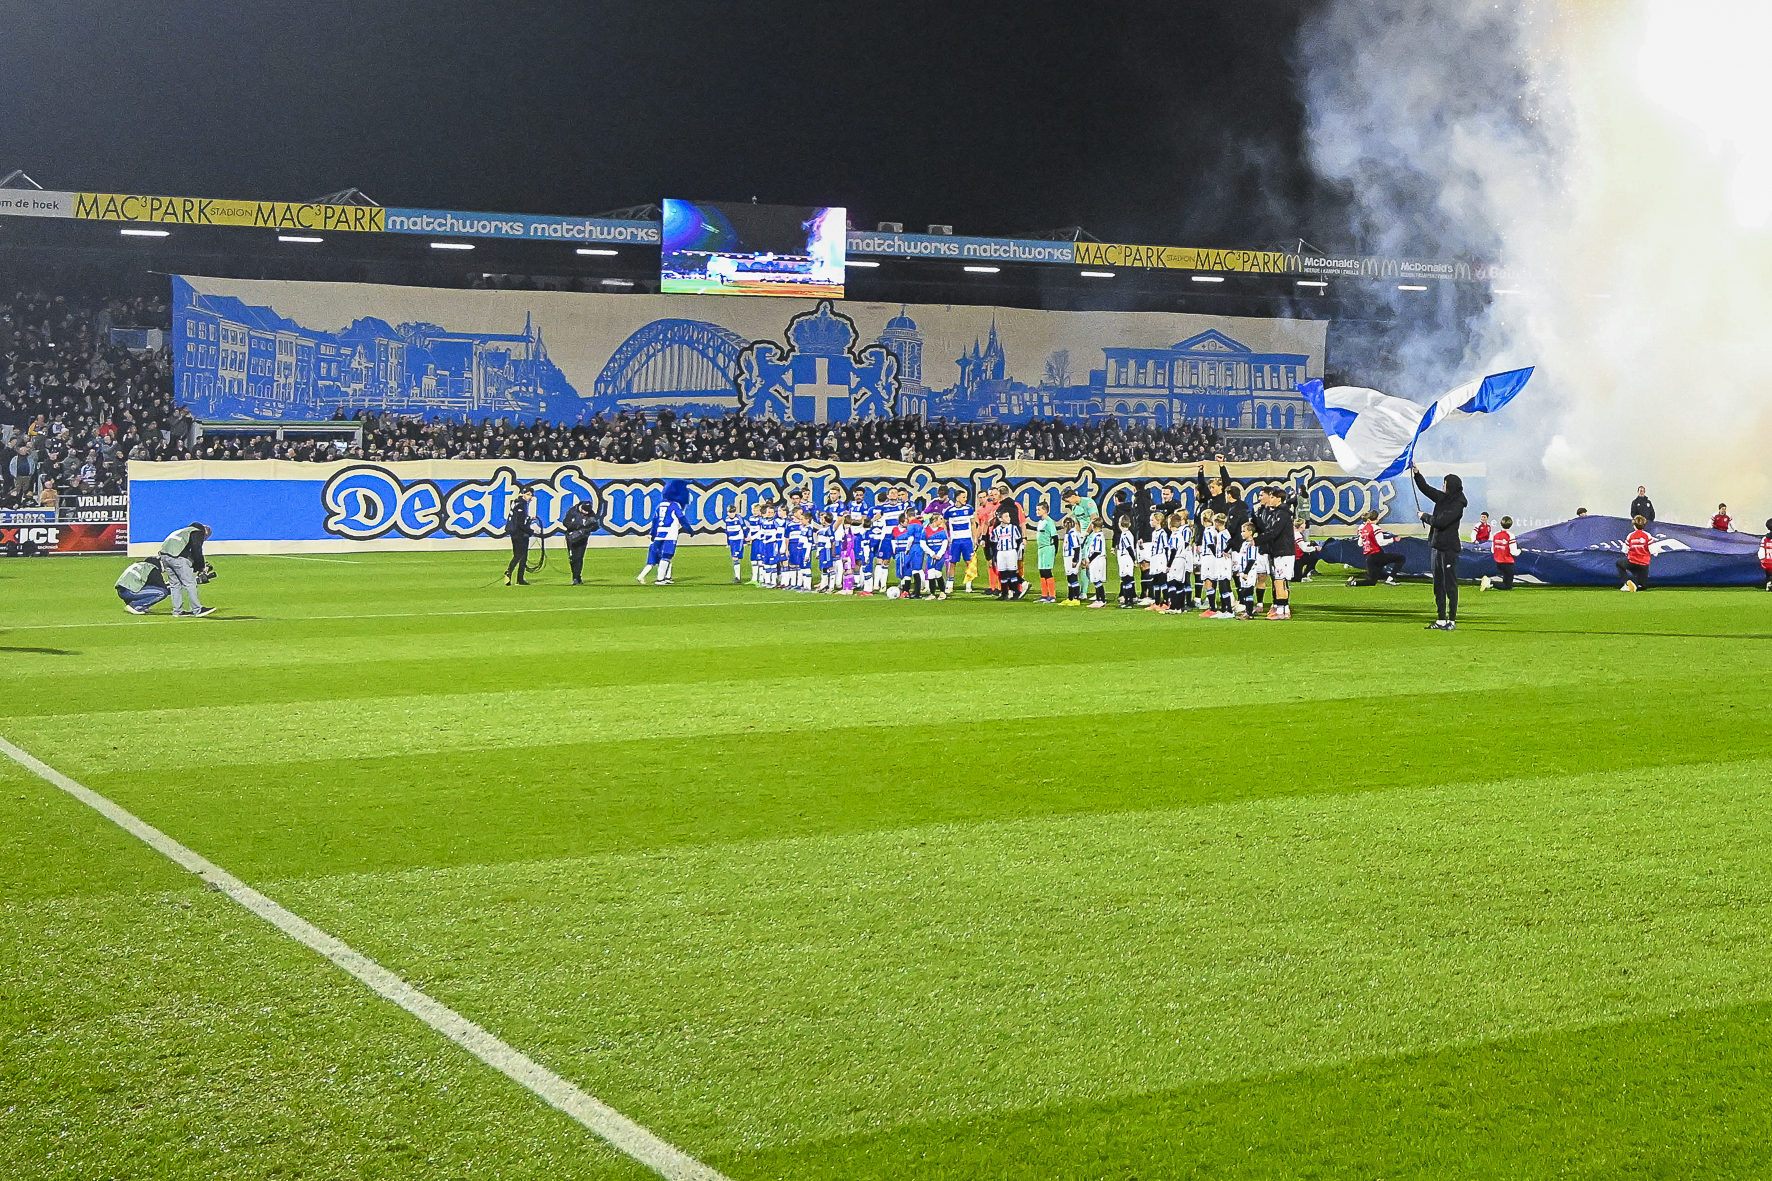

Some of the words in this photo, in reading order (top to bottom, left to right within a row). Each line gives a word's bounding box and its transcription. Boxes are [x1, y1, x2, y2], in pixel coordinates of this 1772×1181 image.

[0, 200, 12, 208] m
[15, 199, 29, 208] de
[210, 207, 253, 217] STADION
[388, 214, 523, 235] matchworks
[530, 221, 659, 242] matchworks
[846, 236, 959, 255] matchworks
[964, 242, 1072, 261] matchworks
[1304, 257, 1360, 269] McDonald's
[322, 465, 441, 540] De
[78, 511, 109, 521] VOOR
